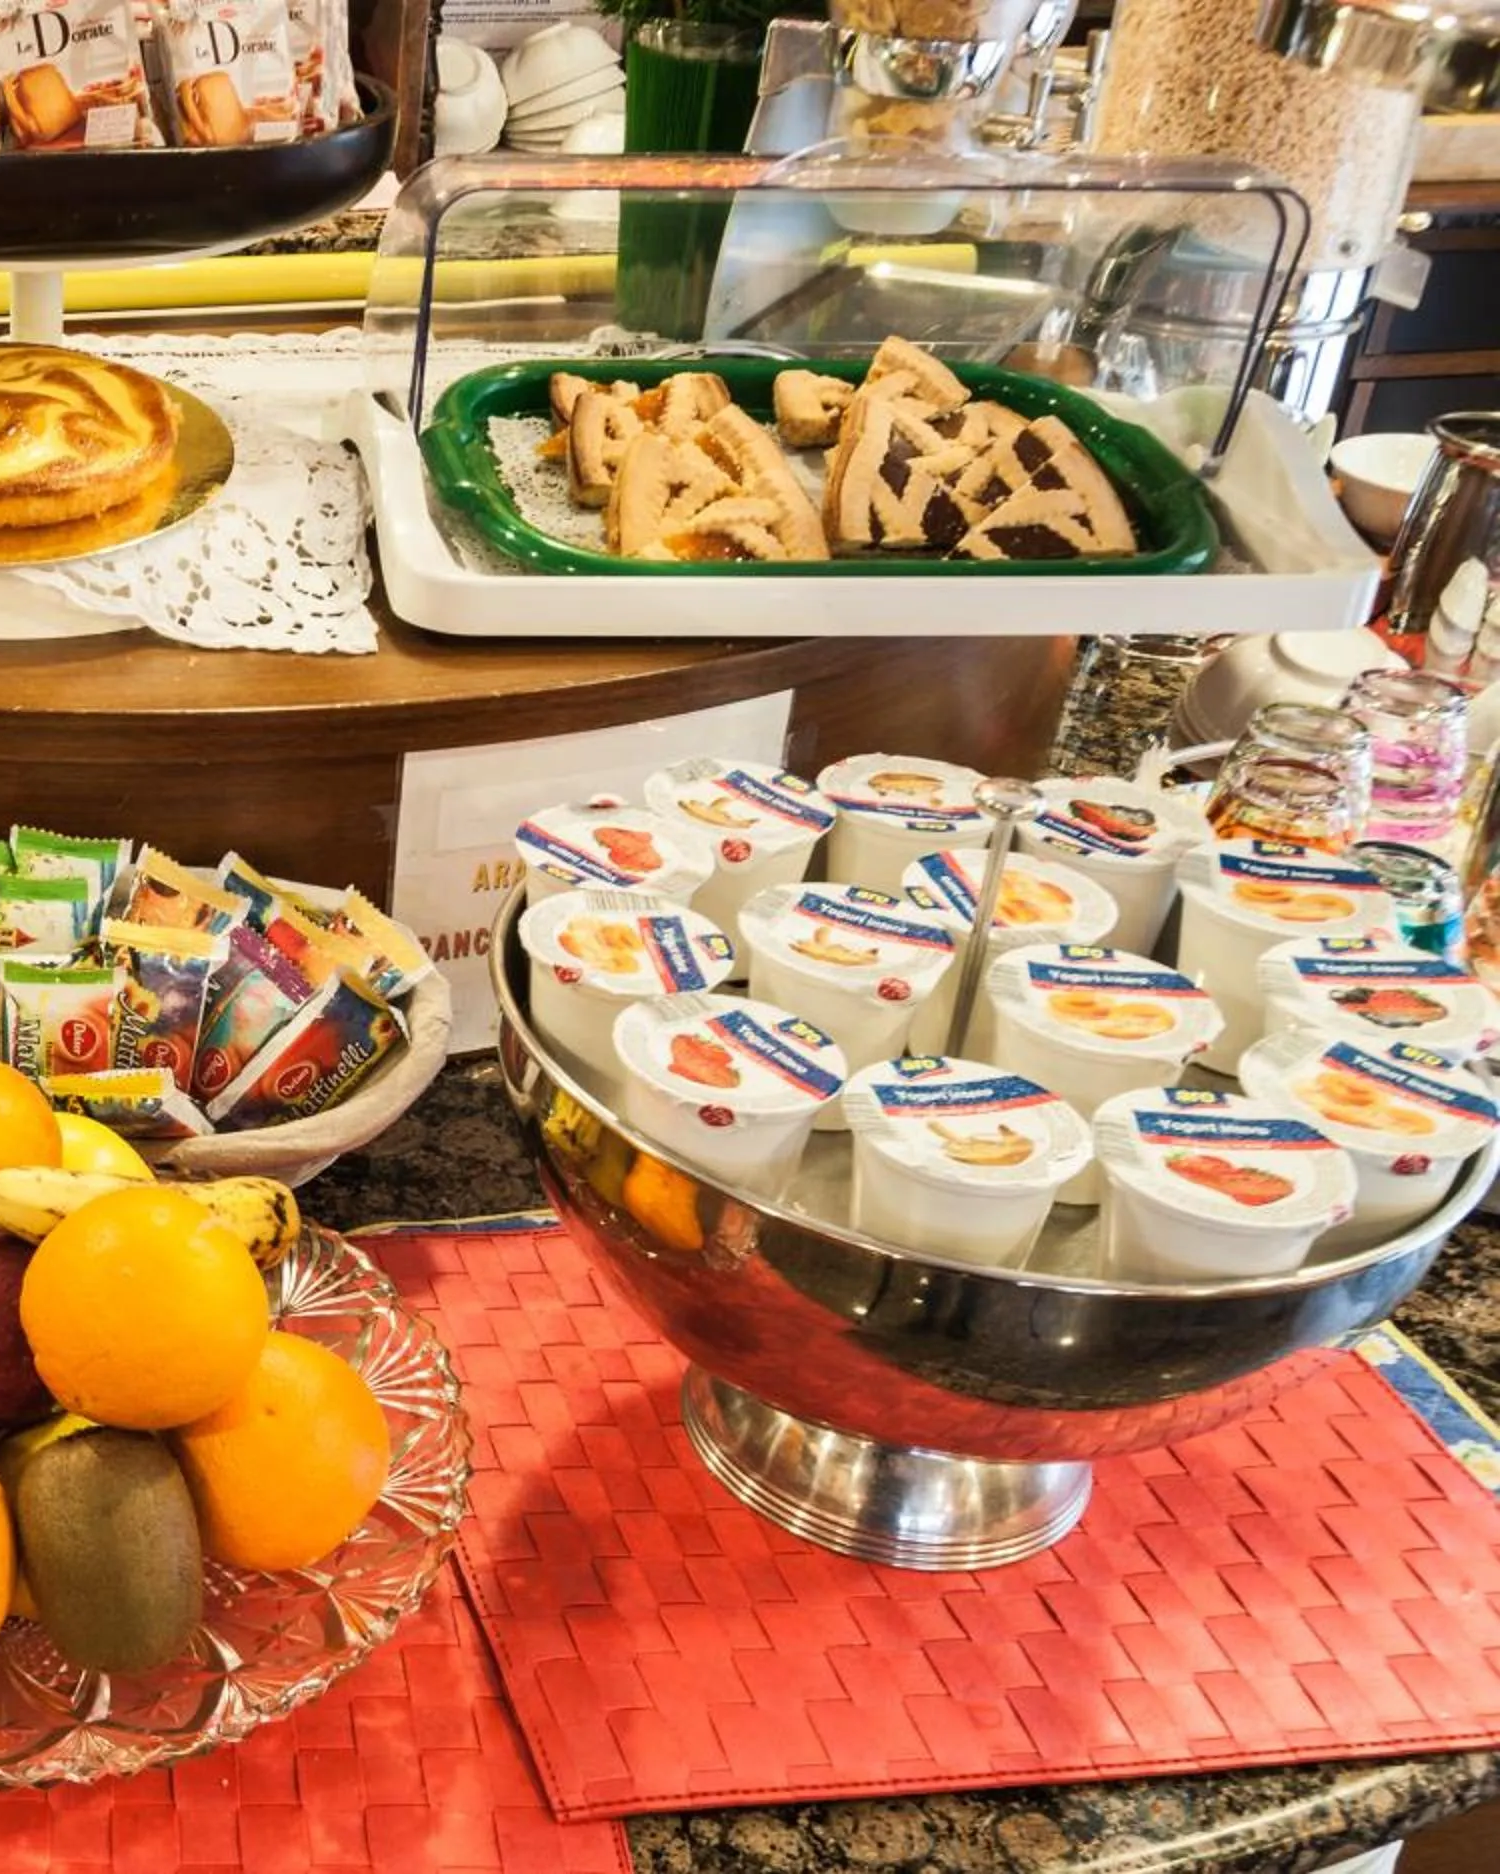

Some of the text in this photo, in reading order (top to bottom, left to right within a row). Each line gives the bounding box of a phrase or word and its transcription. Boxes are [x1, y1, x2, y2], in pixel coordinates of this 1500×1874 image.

[32, 10, 114, 58] Dorate
[206, 20, 277, 65] Dorate
[1238, 861, 1288, 877] Yogurt
[818, 903, 868, 927] Yogurt
[1352, 1054, 1407, 1084] Yogurt
[1156, 1118, 1219, 1135] Yogurt
